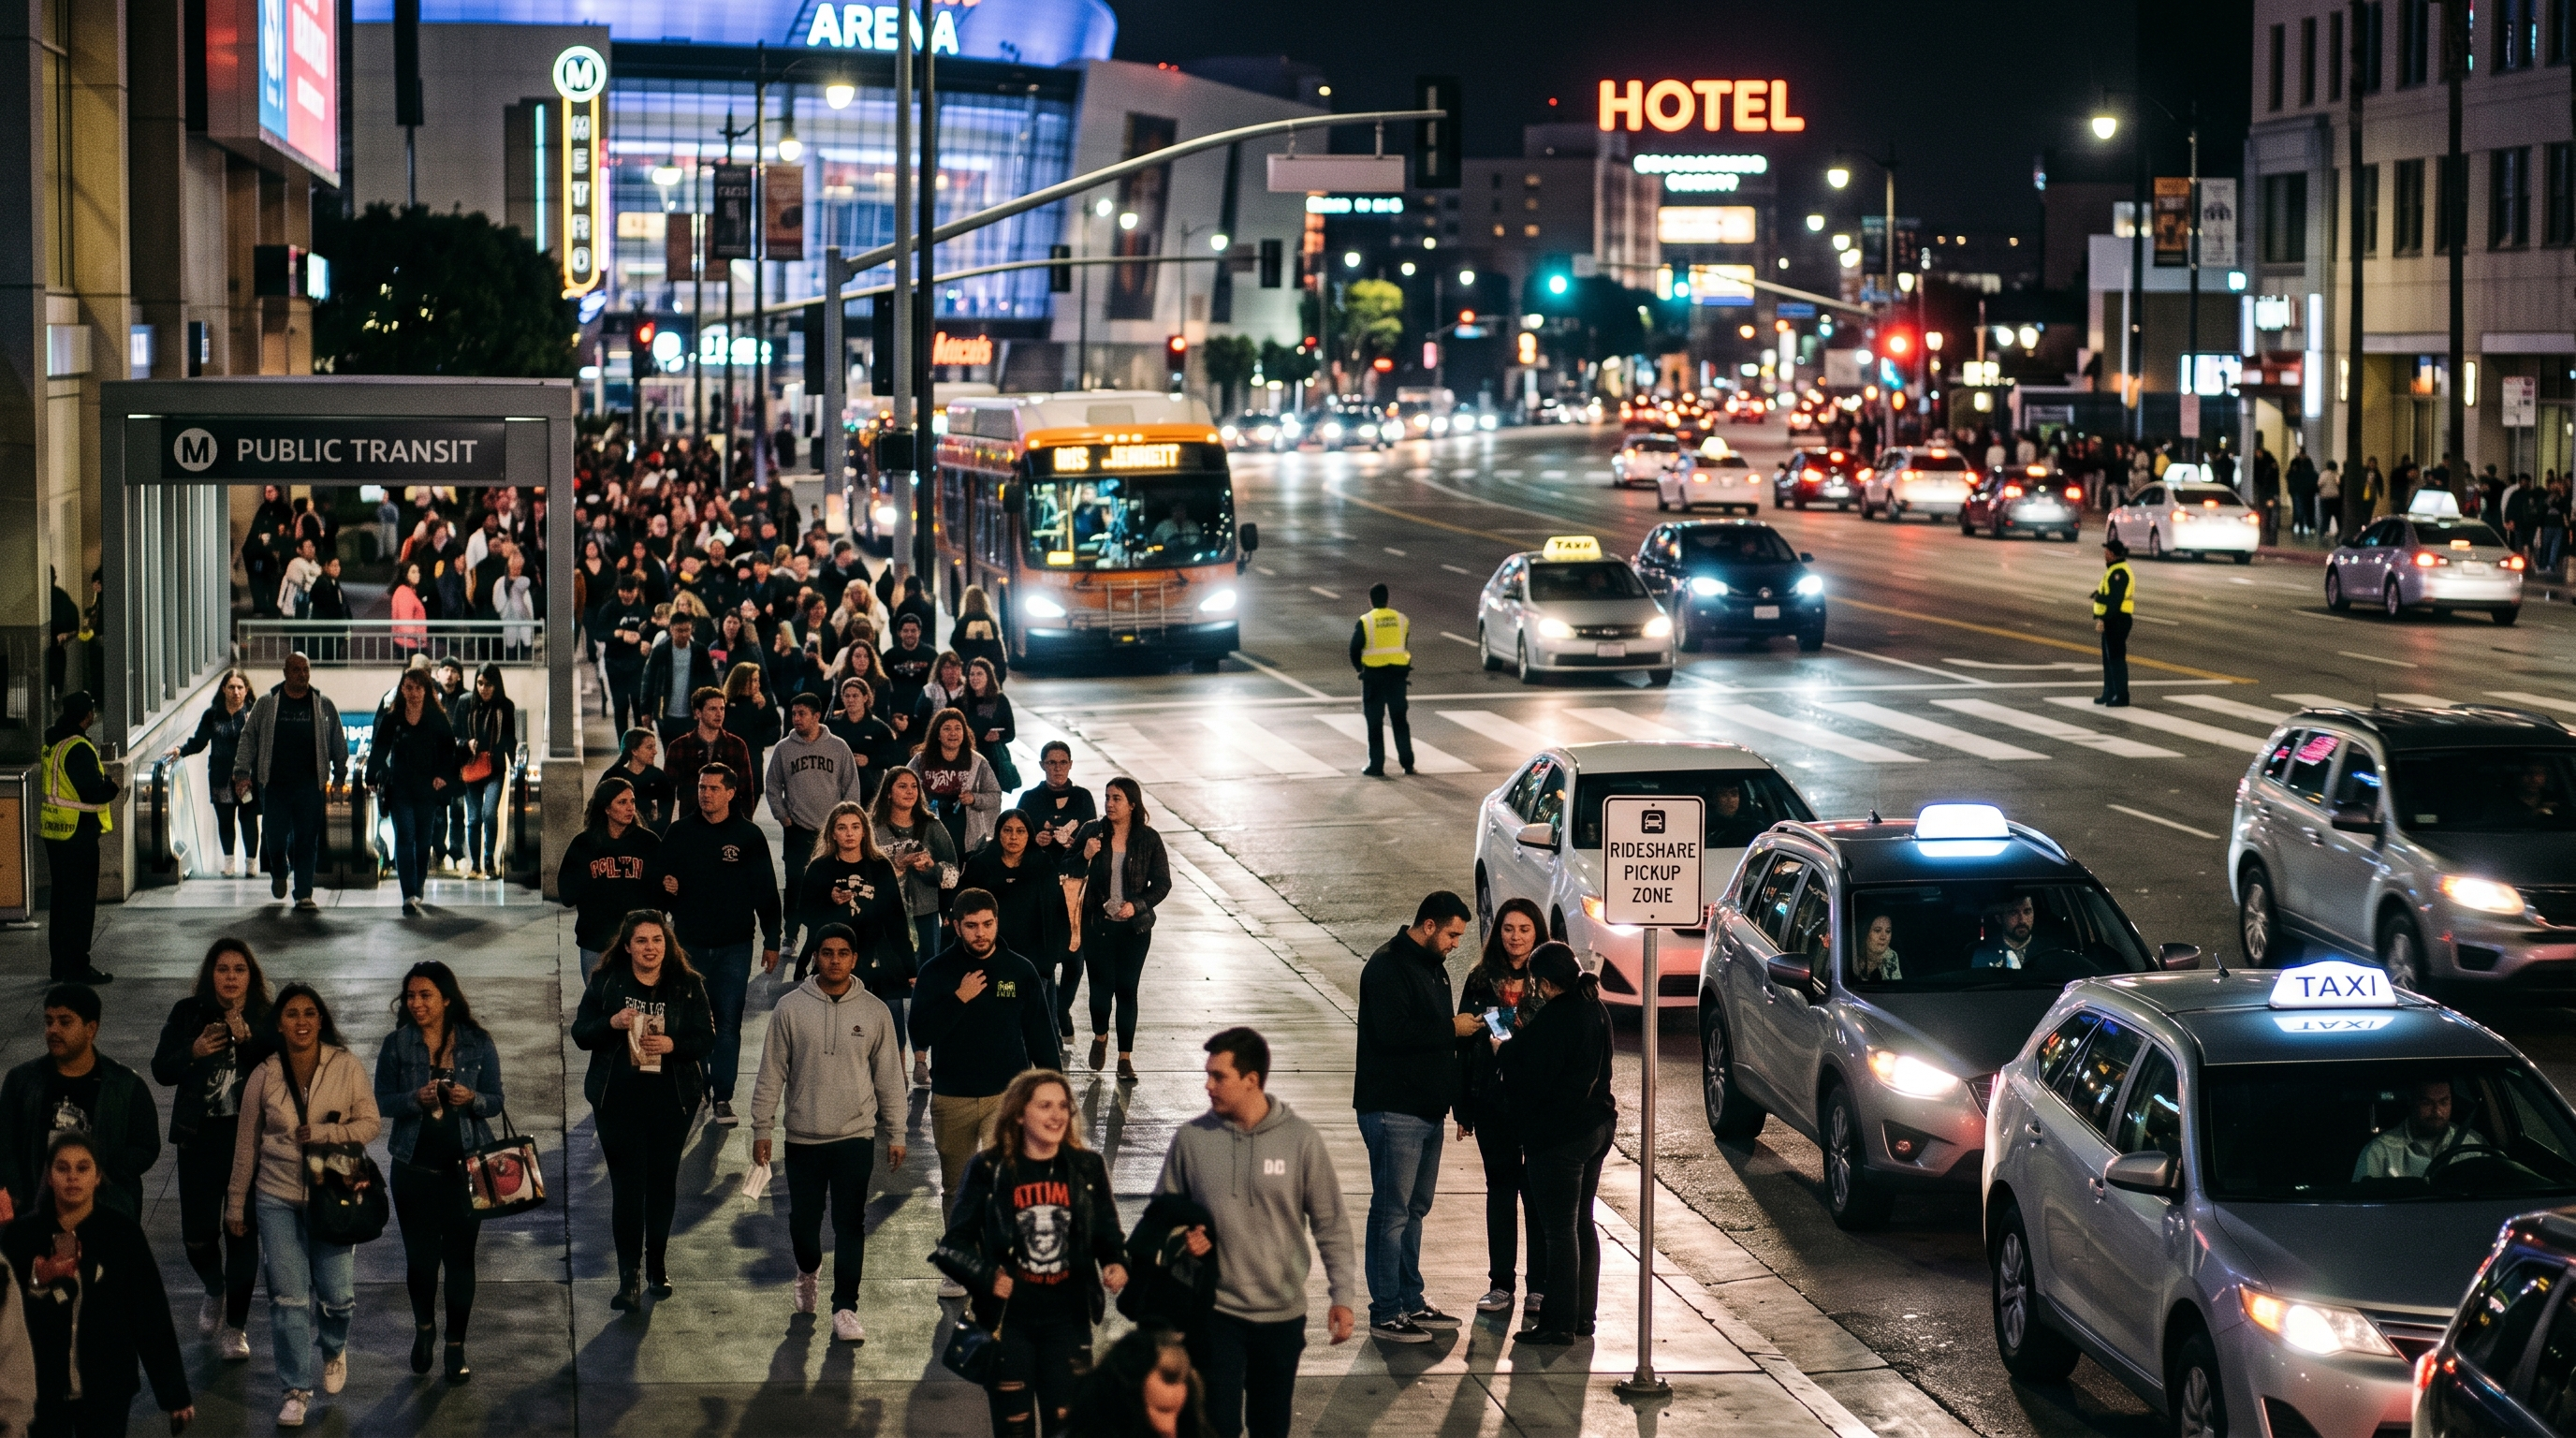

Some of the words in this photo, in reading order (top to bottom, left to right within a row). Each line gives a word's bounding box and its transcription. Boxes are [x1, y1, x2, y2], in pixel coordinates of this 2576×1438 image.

[565, 59, 593, 89] M
[1599, 79, 1806, 132] HOTEL
[571, 114, 591, 273] METRO
[183, 437, 209, 463] M
[238, 438, 342, 462] PUBLIC
[350, 439, 477, 463] TRANSIT
[791, 755, 834, 775] METRO
[1610, 842, 1696, 858] RIDESHARE
[1624, 864, 1681, 881] PICKUP
[1632, 887, 1673, 903] ZONE
[2295, 975, 2377, 997] TAXI
